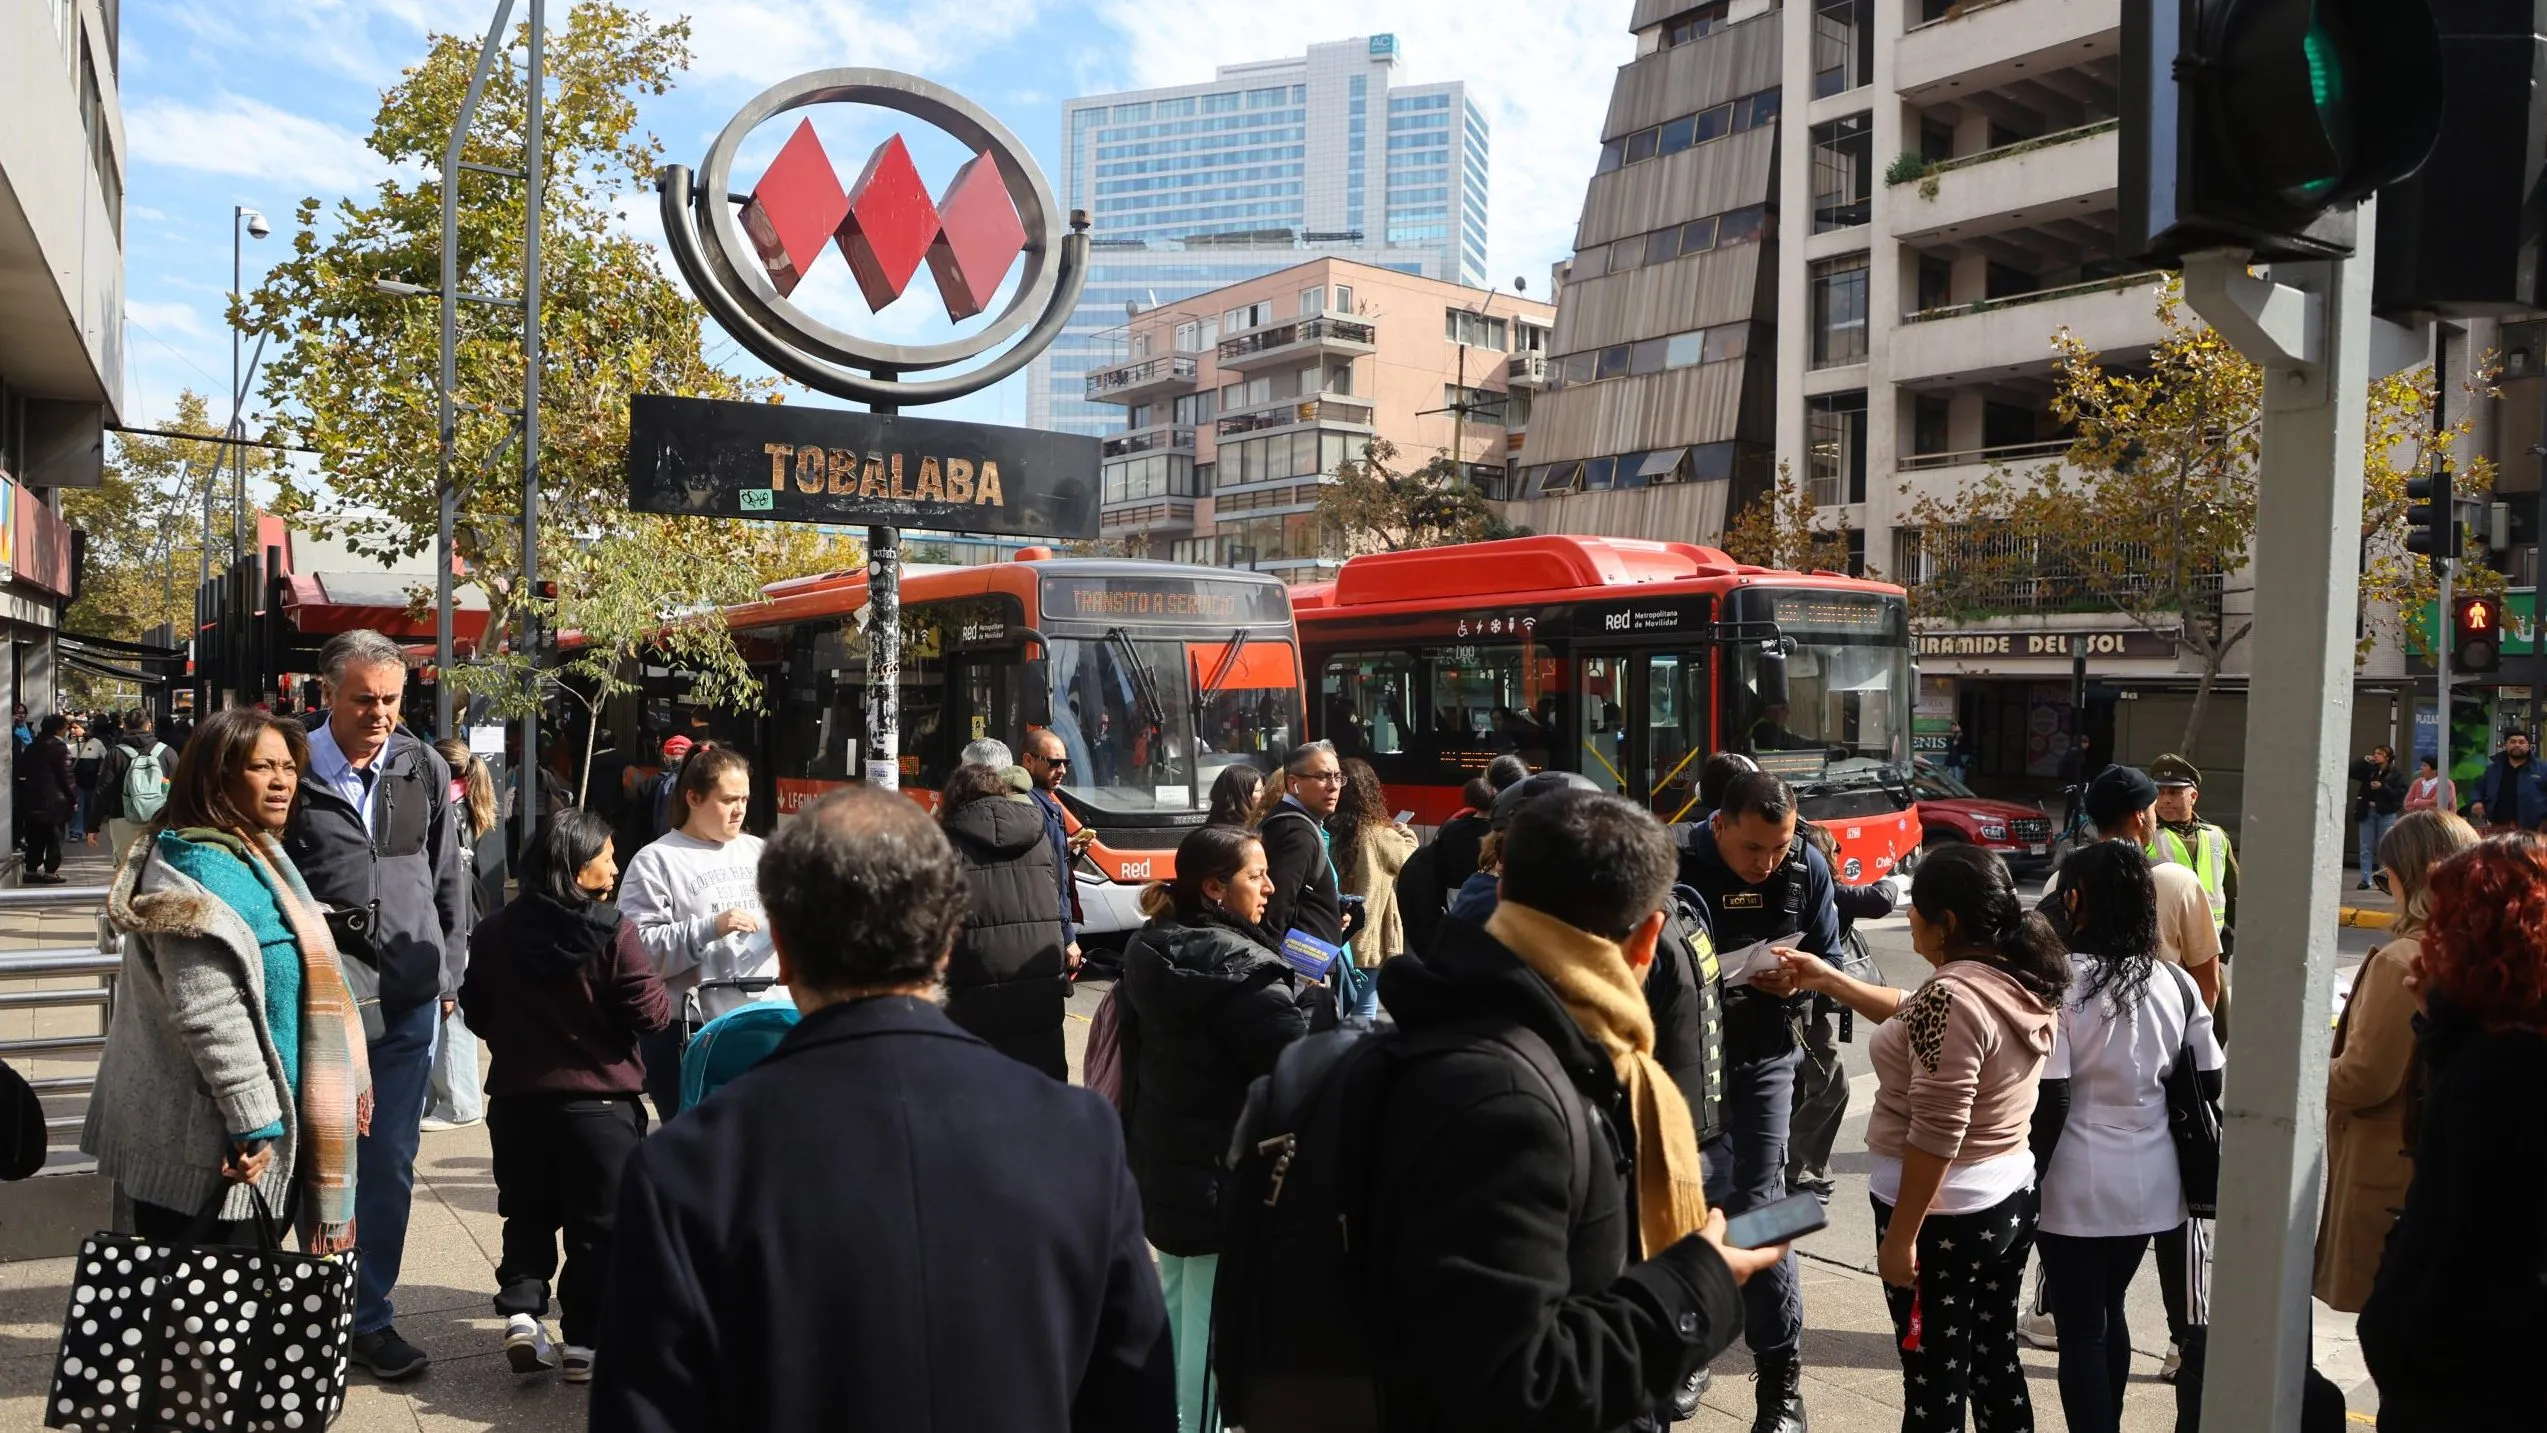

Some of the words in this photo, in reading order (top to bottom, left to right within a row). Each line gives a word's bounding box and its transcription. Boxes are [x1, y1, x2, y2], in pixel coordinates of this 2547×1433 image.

[764, 443, 1004, 506] TOBALABA
[1074, 590, 1149, 613] TRANSITO
[1152, 592, 1163, 613] A
[1167, 593, 1235, 615] SERVICIO
[1605, 609, 1630, 630] Red
[1634, 610, 1678, 620] Metropolitana
[1645, 618, 1678, 628] Movilidad
[962, 621, 977, 641] Red
[2028, 636, 2067, 653] DEL
[2087, 635, 2125, 653] SOL
[1121, 857, 1151, 879] Red
[690, 868, 727, 897] COPPER
